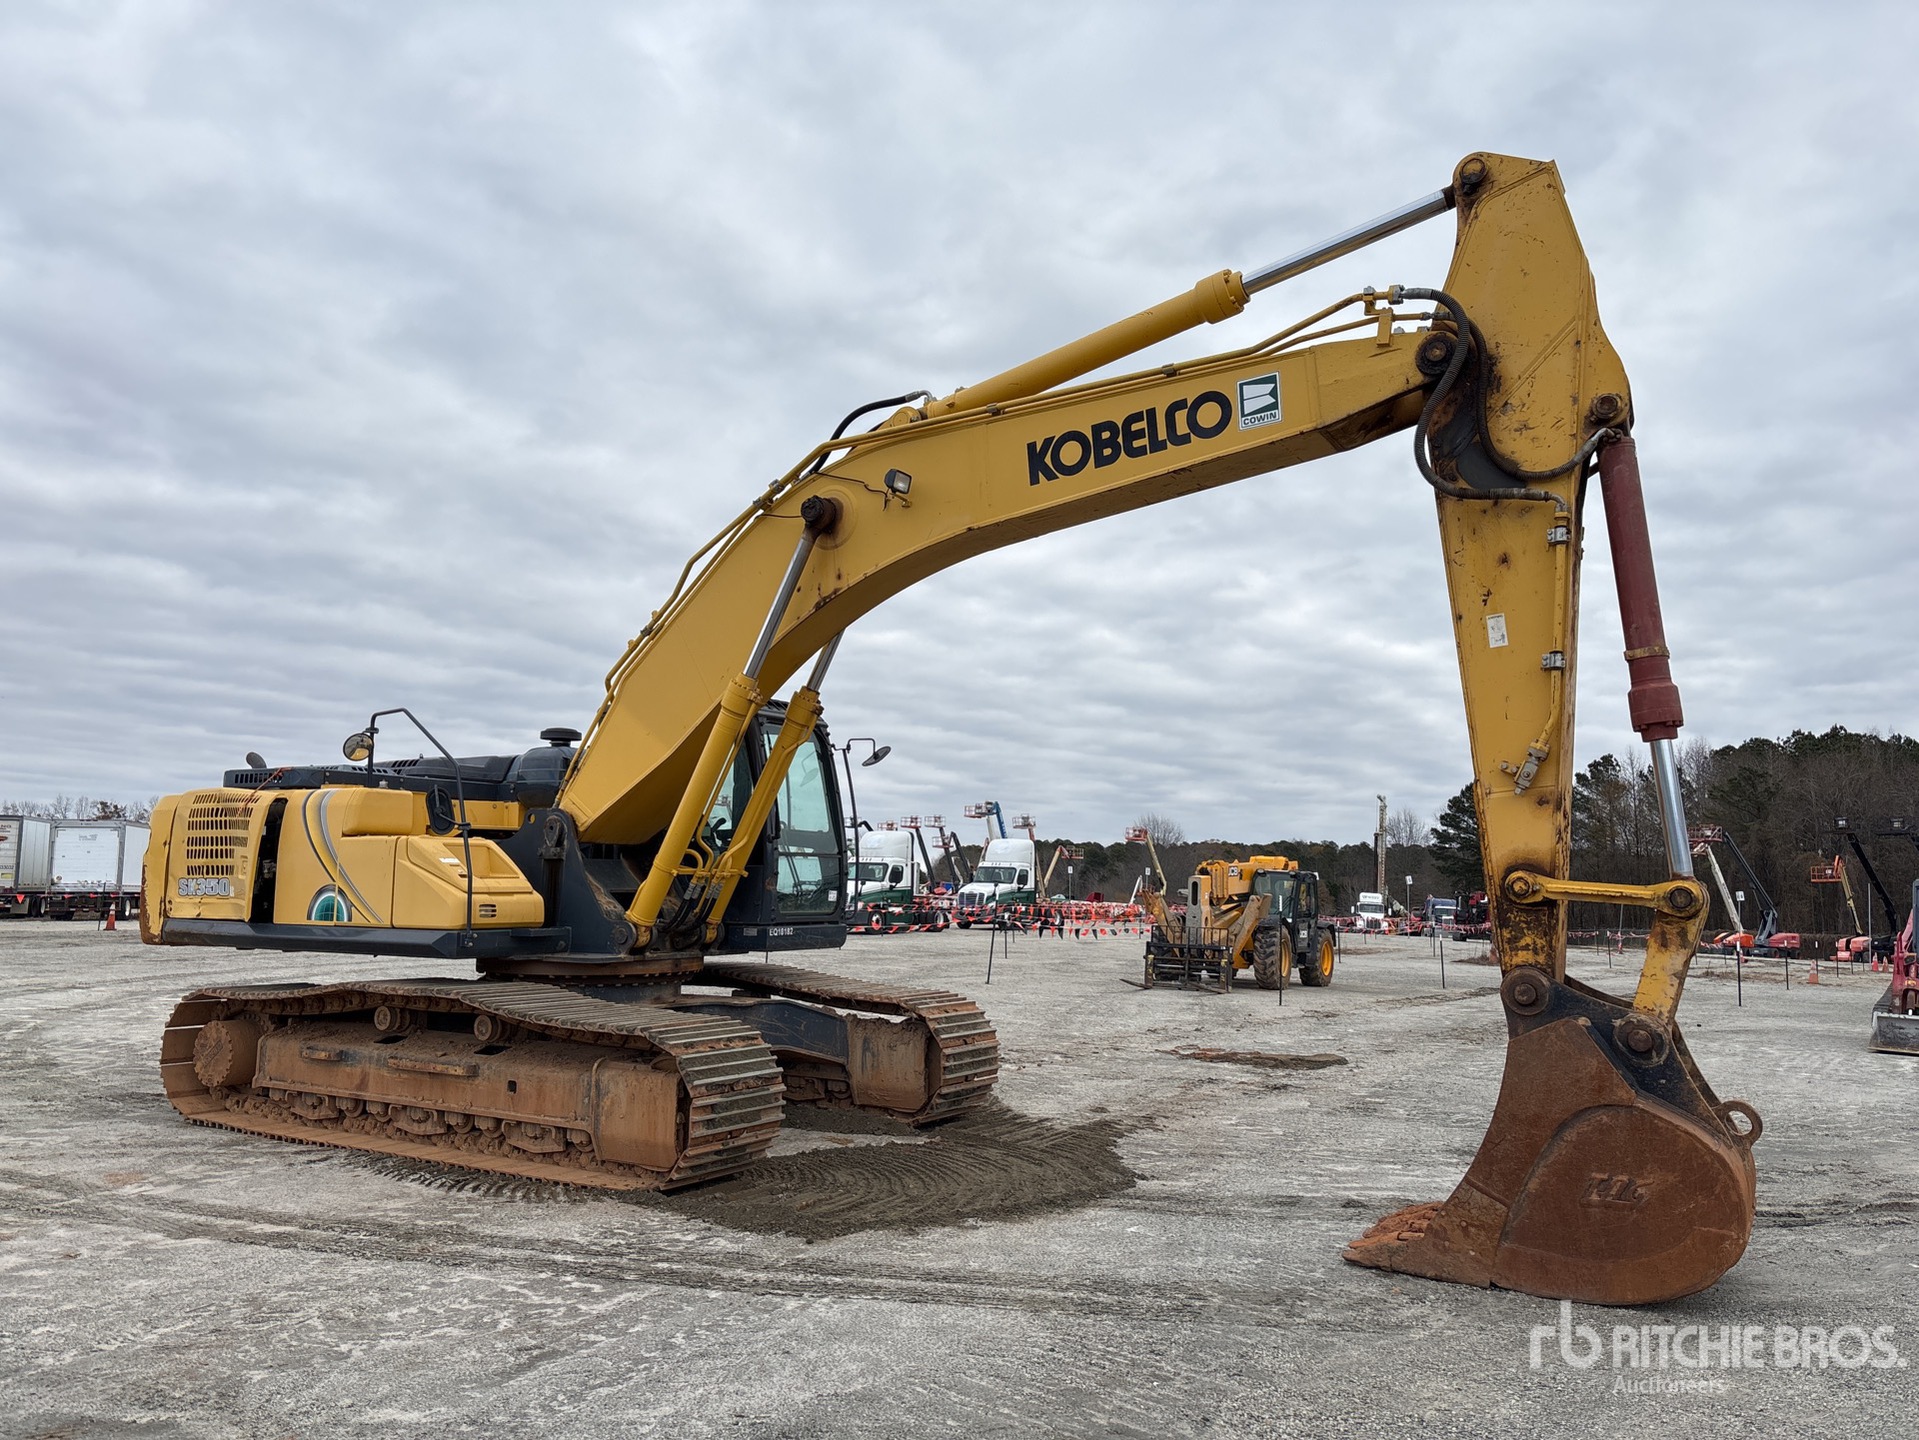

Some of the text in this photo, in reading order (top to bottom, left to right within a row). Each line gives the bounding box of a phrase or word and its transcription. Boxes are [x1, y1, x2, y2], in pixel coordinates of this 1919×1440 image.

[1243, 411, 1277, 426] COWIN
[1026, 390, 1233, 487] KOBELCO
[178, 877, 231, 897] SK350
